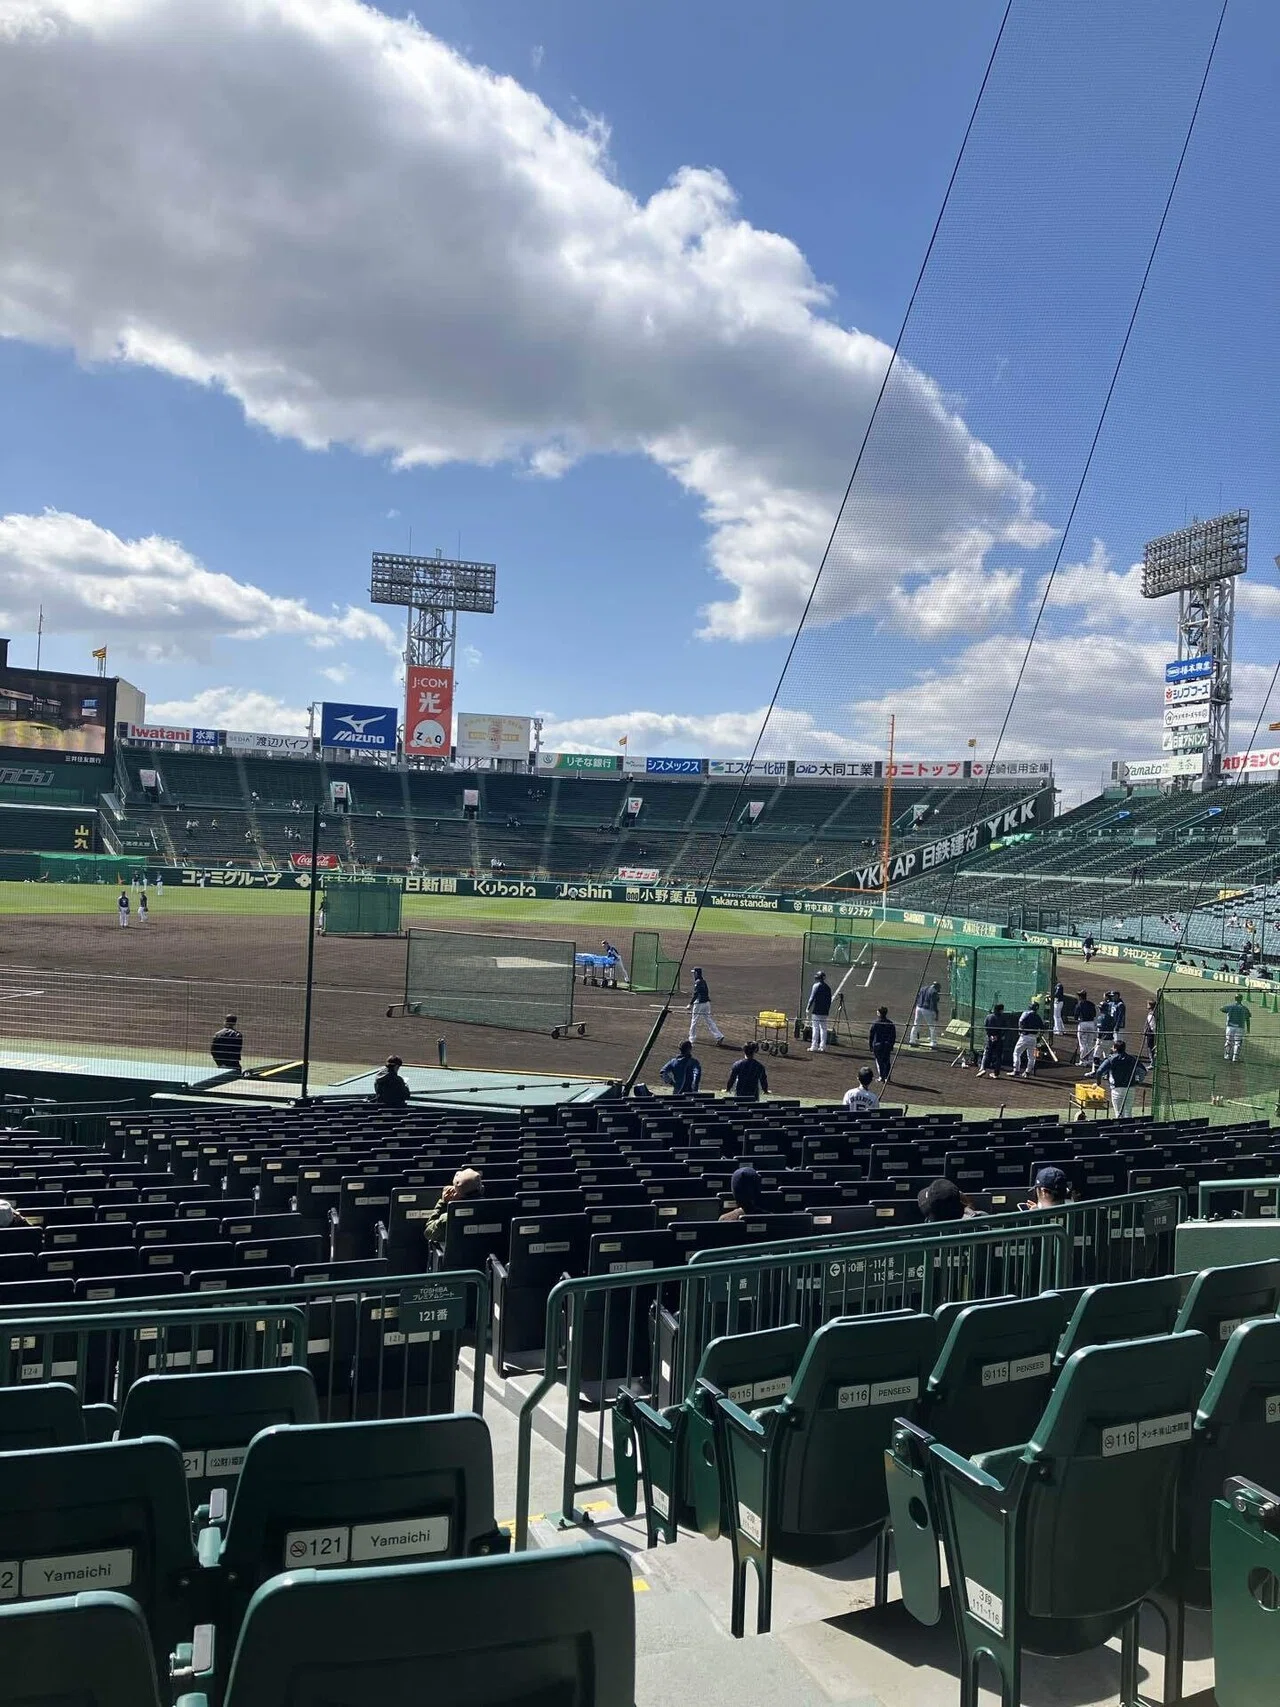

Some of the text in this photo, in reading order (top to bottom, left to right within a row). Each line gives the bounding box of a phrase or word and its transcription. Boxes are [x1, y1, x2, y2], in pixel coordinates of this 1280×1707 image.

[412, 677, 448, 689] J:COM
[419, 691, 442, 714] 光
[131, 725, 190, 742] Iwatani
[566, 757, 612, 769] りそな銀行
[648, 760, 699, 772] シスメックス
[724, 762, 786, 775] エスケー化研
[819, 763, 873, 776] 大同工業
[886, 763, 961, 777] カニトップ
[987, 799, 1036, 838] YKK
[892, 853, 916, 881] AP
[473, 880, 537, 897] Kubota
[559, 883, 613, 899] Joshin
[641, 889, 697, 904] 小野薬品
[711, 895, 778, 909] Takara standard
[419, 1308, 448, 1322] 121番
[993, 1367, 1007, 1379] 115
[850, 1385, 911, 1402] 116 PENSEES
[1116, 1431, 1135, 1447] 116
[183, 1458, 199, 1472] 21
[310, 1529, 431, 1556] 121 Yamaichi
[43, 1563, 112, 1582] Yamaichi
